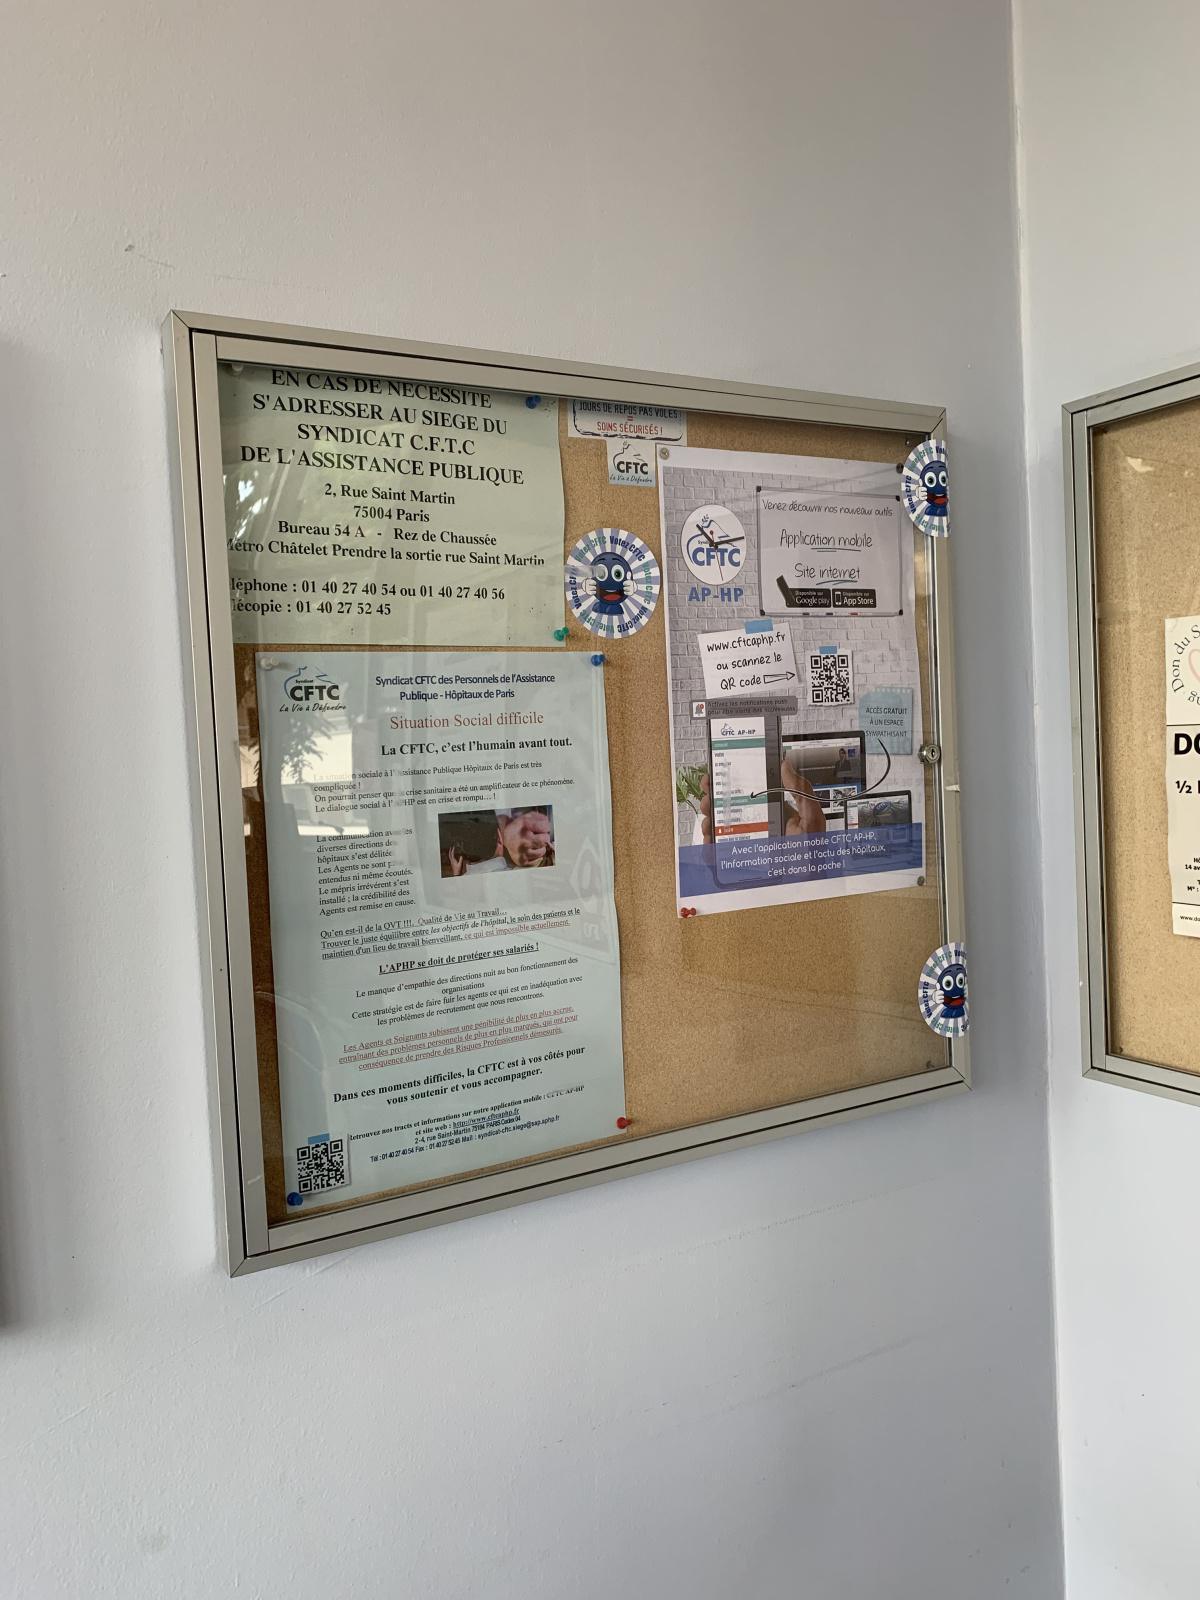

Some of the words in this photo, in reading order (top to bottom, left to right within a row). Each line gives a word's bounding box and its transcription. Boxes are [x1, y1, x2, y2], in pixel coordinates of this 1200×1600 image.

[272, 369, 300, 386] EN
[306, 373, 348, 392] CAS
[354, 378, 382, 394] DE
[387, 381, 492, 408] NECESSITE
[253, 394, 383, 419] S'ADRESSER
[390, 406, 417, 423] AU
[422, 410, 479, 430] SIEGE
[483, 418, 507, 434] DU
[579, 401, 601, 412] JOURS
[604, 403, 612, 412] DE
[615, 403, 637, 414] REPOS
[639, 408, 653, 416] PAS
[597, 422, 617, 431] SOINS
[620, 421, 658, 435] SÉCURISÉS
[298, 423, 404, 448] SYNDICAT
[410, 434, 475, 455] C.F.T.C
[241, 446, 271, 462] DE
[277, 448, 424, 476] L'ASSISTANCE
[430, 462, 524, 486] PUBLIQUE
[617, 461, 648, 474] CFTC
[325, 483, 336, 497] 2,
[341, 485, 368, 498] Rue
[372, 488, 406, 501] Saint
[410, 490, 455, 505] Martin
[353, 506, 392, 520] 75004
[396, 509, 430, 522] Paris
[762, 500, 786, 511] Venez
[825, 506, 837, 514] nos
[278, 521, 330, 536] Bureau
[334, 524, 350, 536] 54
[355, 526, 365, 538] A
[394, 528, 417, 541] Rez
[422, 530, 436, 542] de
[440, 531, 497, 545] Chaussée
[780, 529, 836, 548] Application
[838, 533, 872, 547] mobile
[268, 540, 328, 556] Châtelet
[332, 544, 386, 559] Prendre
[391, 547, 402, 560] la
[406, 549, 441, 561] sortie
[445, 553, 466, 563] rue
[469, 552, 500, 564] Saint
[504, 554, 545, 567] Martin
[628, 543, 645, 561] CFTC
[692, 547, 740, 567] CFTC
[795, 563, 815, 578] Site
[820, 566, 860, 578] internet
[231, 578, 287, 594] léphone
[302, 580, 316, 593] 01
[322, 581, 337, 594] 40
[342, 582, 357, 594] 27
[362, 583, 377, 595] 40
[381, 584, 396, 596] 54
[400, 587, 416, 597] ou
[420, 585, 433, 597] 01
[438, 586, 452, 598] 40
[456, 587, 470, 598] 27
[474, 588, 487, 599] 40
[492, 588, 505, 600] 56
[688, 587, 743, 602] AP-HP
[296, 601, 310, 613] 01
[317, 601, 332, 613] 40
[337, 602, 352, 614] 27
[357, 603, 372, 615] 52
[376, 603, 391, 615] 45
[844, 597, 856, 606] App
[858, 597, 873, 605] Store
[707, 632, 785, 652] www.cftcaphp.fr
[1174, 637, 1190, 655] du
[732, 656, 770, 668] scannez
[774, 652, 781, 662] le
[376, 676, 413, 687] Syndicat
[415, 676, 437, 685] CFTC
[438, 675, 453, 684] des
[455, 674, 498, 684] Personnels
[500, 675, 510, 683] de
[512, 673, 555, 682] l'Assistance
[721, 677, 736, 690] QR
[740, 675, 761, 687] code
[1172, 659, 1184, 692] Don
[290, 685, 339, 701] CFTC
[400, 691, 438, 702] Publique
[445, 689, 482, 700] Hôpitaux
[484, 690, 494, 698] de
[496, 690, 515, 698] Paris
[390, 716, 449, 729] Situation
[454, 713, 492, 727] Social
[497, 712, 544, 725] difficile
[381, 745, 396, 755] La
[400, 743, 438, 755] CFTC,
[442, 742, 466, 752] c'est
[469, 740, 515, 751] l'humain
[519, 739, 547, 749] avant
[550, 738, 572, 747] tout.
[464, 765, 493, 773] Hôpitaux
[503, 762, 519, 770] Paris
[732, 846, 752, 855] Avec
[755, 841, 801, 853] l'application
[804, 838, 828, 847] mobile
[831, 834, 851, 844] CFTC
[721, 857, 772, 869] l'information
[774, 854, 801, 862] sociale
[814, 850, 835, 859] l'actu
[837, 848, 850, 856] des
[768, 868, 786, 877] c'est
[818, 861, 842, 872] poche
[428, 956, 443, 966] doit
[446, 955, 455, 963] de
[458, 951, 491, 964] protéger
[506, 944, 534, 954] salariés
[334, 1091, 358, 1102] Dans
[361, 1088, 375, 1097] ces
[379, 1079, 420, 1094] moments
[424, 1070, 464, 1085] difficiles,
[467, 1068, 475, 1076] la
[478, 1061, 505, 1074] CFTC
[507, 1058, 518, 1068] est
[521, 1057, 526, 1065] à
[529, 1054, 542, 1063] vos
[544, 1050, 564, 1061] côtés
[566, 1047, 585, 1058] pour
